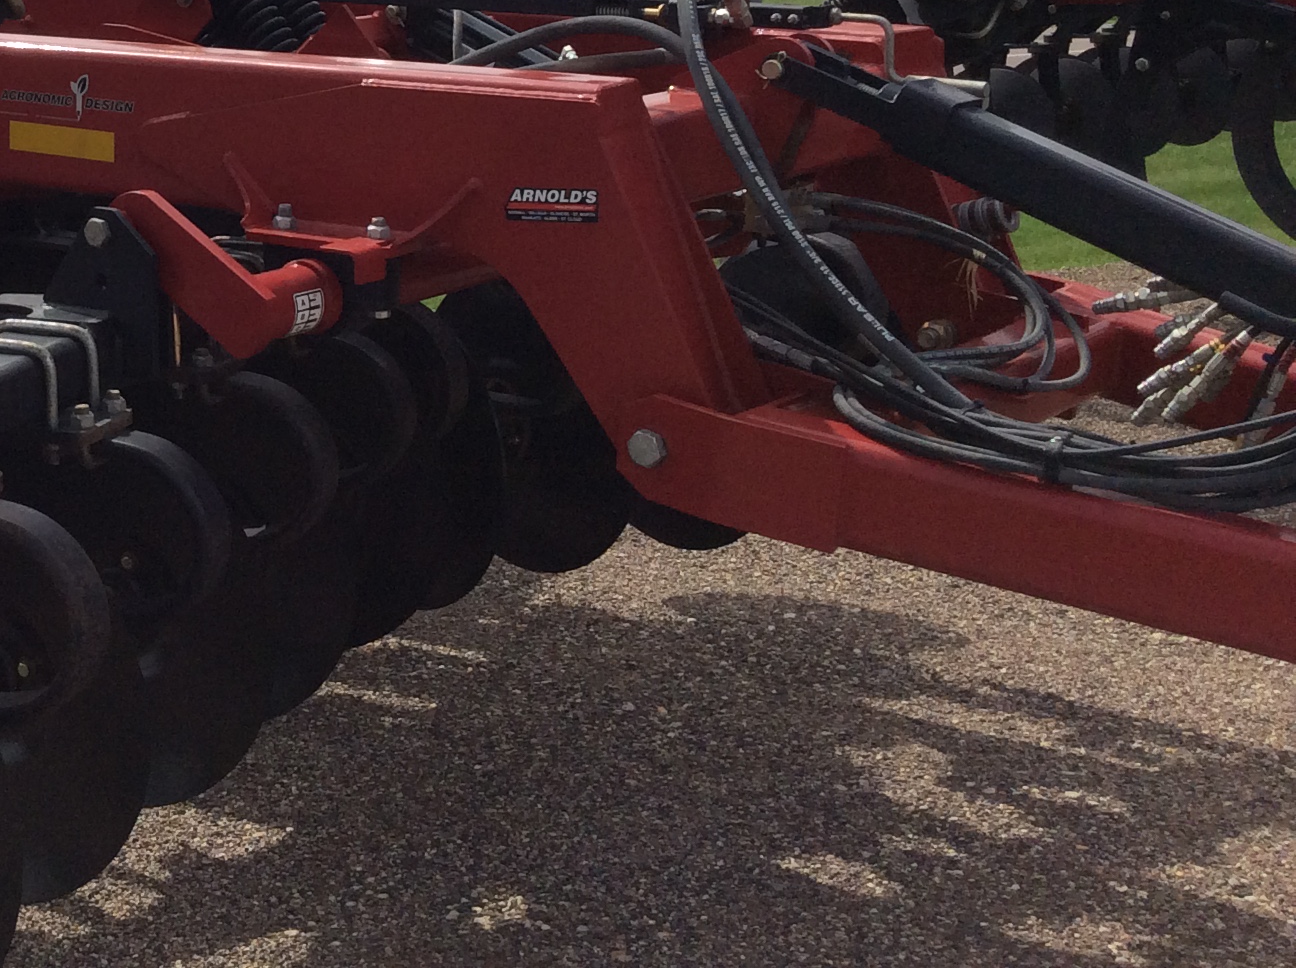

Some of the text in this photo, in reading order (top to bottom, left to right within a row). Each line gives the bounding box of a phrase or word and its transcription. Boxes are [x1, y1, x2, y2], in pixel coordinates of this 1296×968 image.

[0, 89, 135, 113] AGRONOMIC DESIGN
[510, 188, 597, 203] ARNOLD'S
